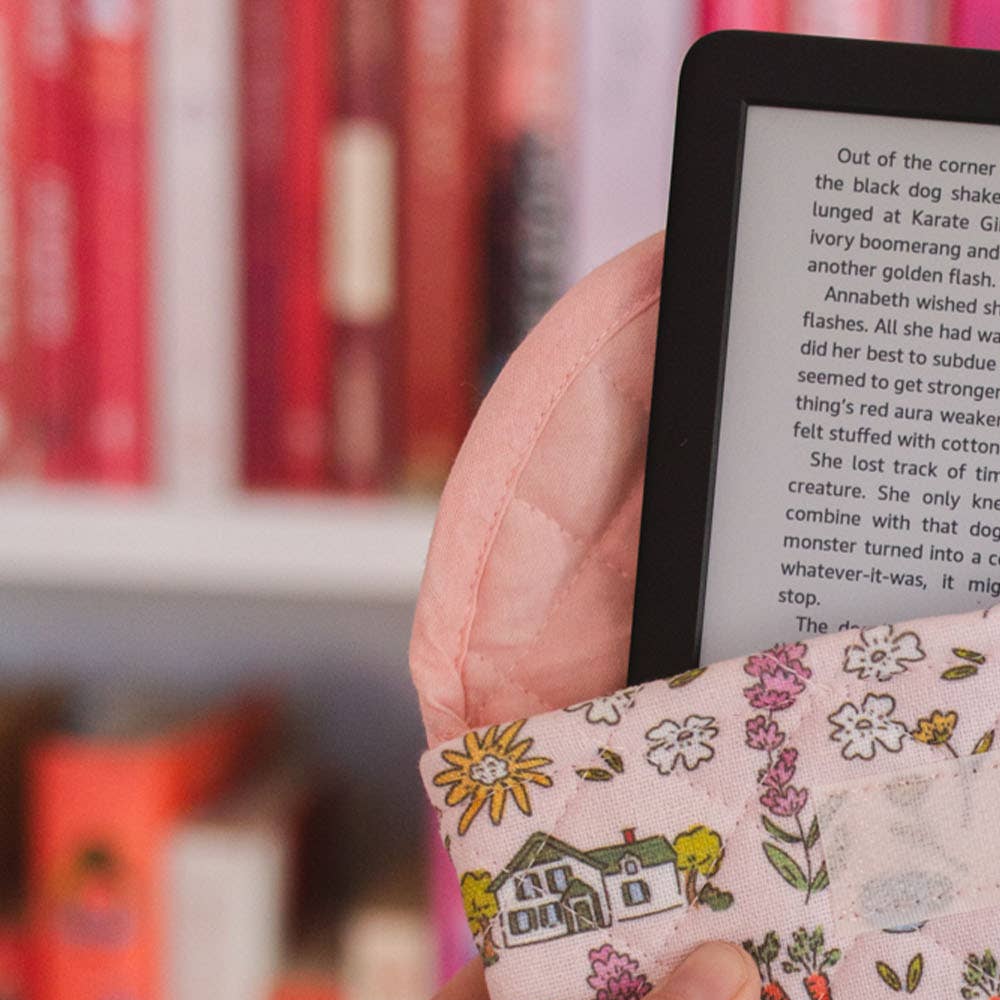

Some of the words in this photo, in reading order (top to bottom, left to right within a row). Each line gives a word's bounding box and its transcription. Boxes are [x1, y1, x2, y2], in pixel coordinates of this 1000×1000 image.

[837, 147, 871, 166] Out
[877, 151, 897, 168] of
[903, 153, 932, 171] the
[939, 160, 997, 176] corner
[815, 174, 844, 191] the
[853, 176, 900, 196] black
[908, 181, 942, 203] dog
[812, 201, 874, 224] lunged
[883, 209, 902, 224] at
[912, 209, 970, 230] Karate
[810, 229, 855, 252] ivory
[859, 232, 961, 257] boomerang
[967, 244, 1000, 260] and
[807, 259, 877, 278] another
[882, 264, 943, 283] golden
[949, 267, 996, 288] flash.
[824, 285, 910, 308] Annabeth
[916, 294, 977, 314] wished
[802, 310, 868, 333] flashes.
[874, 318, 898, 335] All
[903, 321, 934, 338] she
[939, 323, 972, 342] had
[800, 339, 828, 357] did
[832, 341, 861, 360] her
[866, 344, 904, 364] best
[908, 349, 927, 366] to
[932, 352, 997, 372] subdue
[797, 370, 867, 388] seemed
[870, 374, 889, 390] to
[893, 377, 923, 395] get
[859, 402, 889, 418] red
[894, 406, 933, 422] aura
[793, 421, 824, 440] felt
[829, 426, 892, 446] stuffed
[897, 432, 936, 450] with
[810, 451, 843, 469] She
[852, 454, 885, 473] lost
[893, 459, 938, 478] track
[947, 463, 967, 480] of
[788, 481, 866, 499] creature.
[877, 484, 910, 503] She
[922, 490, 961, 511] only
[785, 507, 861, 526] combine
[872, 513, 911, 531] with
[921, 517, 959, 535] that
[783, 536, 858, 554] monster
[864, 540, 924, 560] turned
[929, 544, 964, 563] into
[971, 552, 982, 565] a
[781, 560, 927, 590] whatever-it-was,
[942, 573, 955, 590] it
[778, 588, 820, 609] stop.
[796, 616, 828, 634] The
